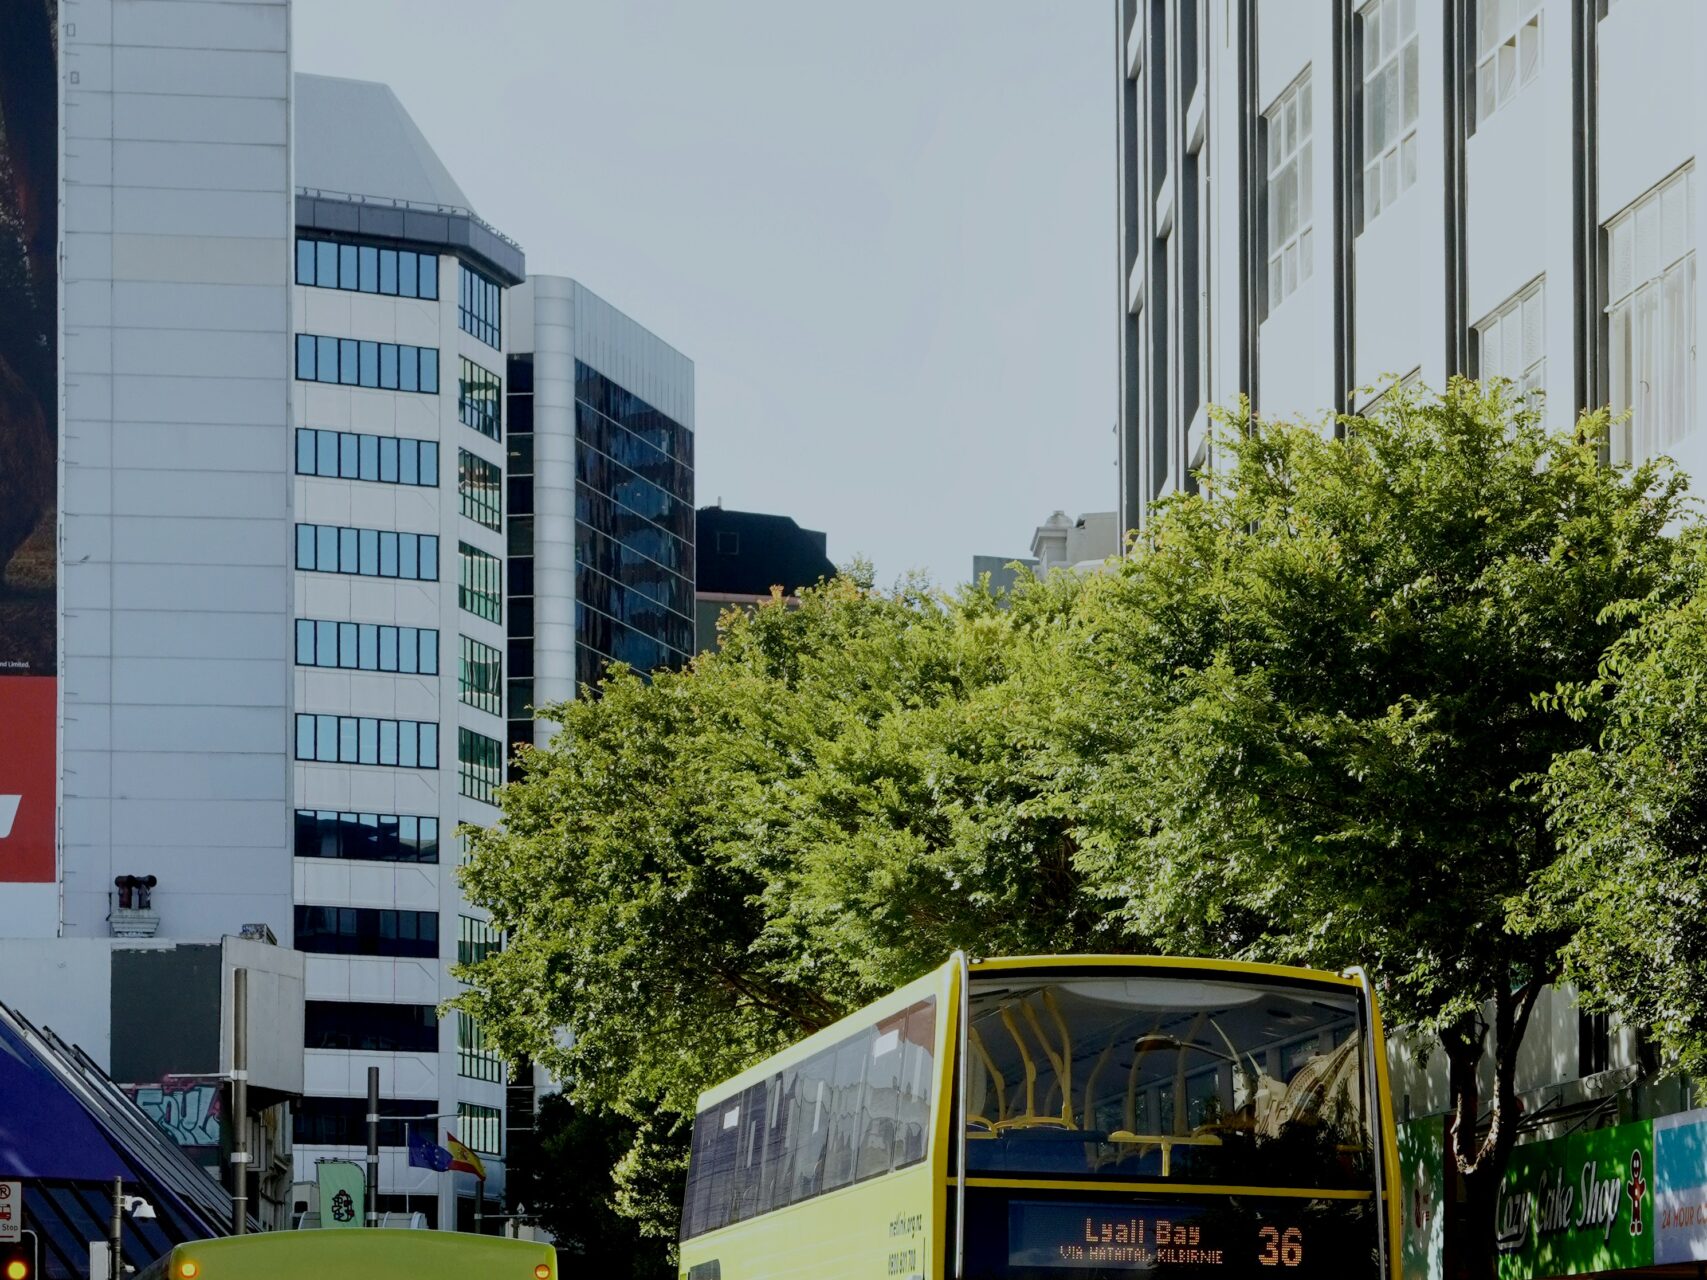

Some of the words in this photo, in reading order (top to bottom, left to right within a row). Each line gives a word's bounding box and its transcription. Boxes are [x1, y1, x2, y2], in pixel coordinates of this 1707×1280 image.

[1494, 1176, 1533, 1251] Cozy
[1536, 1166, 1574, 1235] Cake
[1575, 1160, 1622, 1241] Shop
[2, 1223, 18, 1232] Stop
[1086, 1217, 1144, 1244] Lyall
[1156, 1220, 1200, 1245] Bay
[1060, 1245, 1083, 1260] VIA
[1157, 1248, 1223, 1264] KILBIRNIE
[1258, 1225, 1302, 1267] 36
